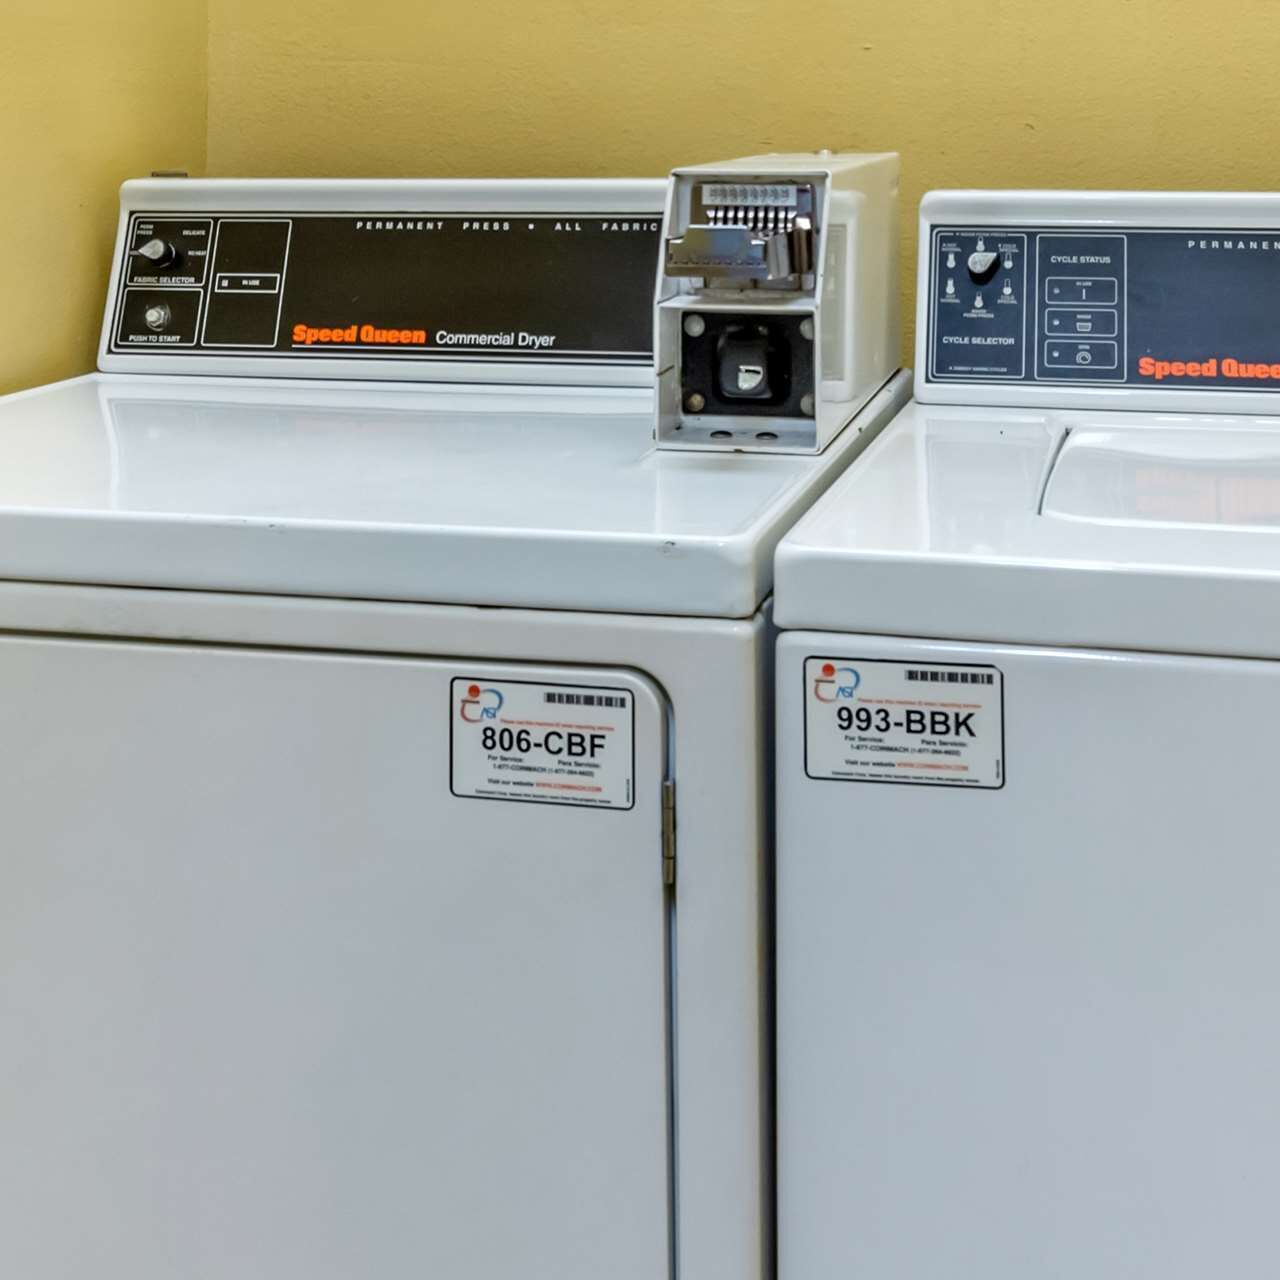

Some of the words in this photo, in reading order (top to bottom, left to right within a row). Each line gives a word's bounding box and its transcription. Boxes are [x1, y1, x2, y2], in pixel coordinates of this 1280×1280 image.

[356, 220, 445, 231] PERMANENT
[463, 221, 512, 232] PRESS
[554, 221, 583, 232] ALL
[601, 222, 659, 233] FABRIC
[1050, 255, 1078, 264] CYCLE
[1079, 256, 1111, 264] STATUS
[133, 276, 158, 284] FABRIC
[148, 335, 158, 343] TO
[158, 335, 181, 343] START
[292, 324, 357, 347] Speed
[360, 326, 427, 345] Queen
[435, 330, 515, 347] Commercial
[517, 332, 556, 350] Dryer
[942, 336, 970, 344] CYCLE
[971, 337, 1015, 345] SELECTOR
[1138, 357, 1219, 380] Speed
[837, 706, 977, 738] 993-BBK
[481, 726, 607, 758] 806-CBF
